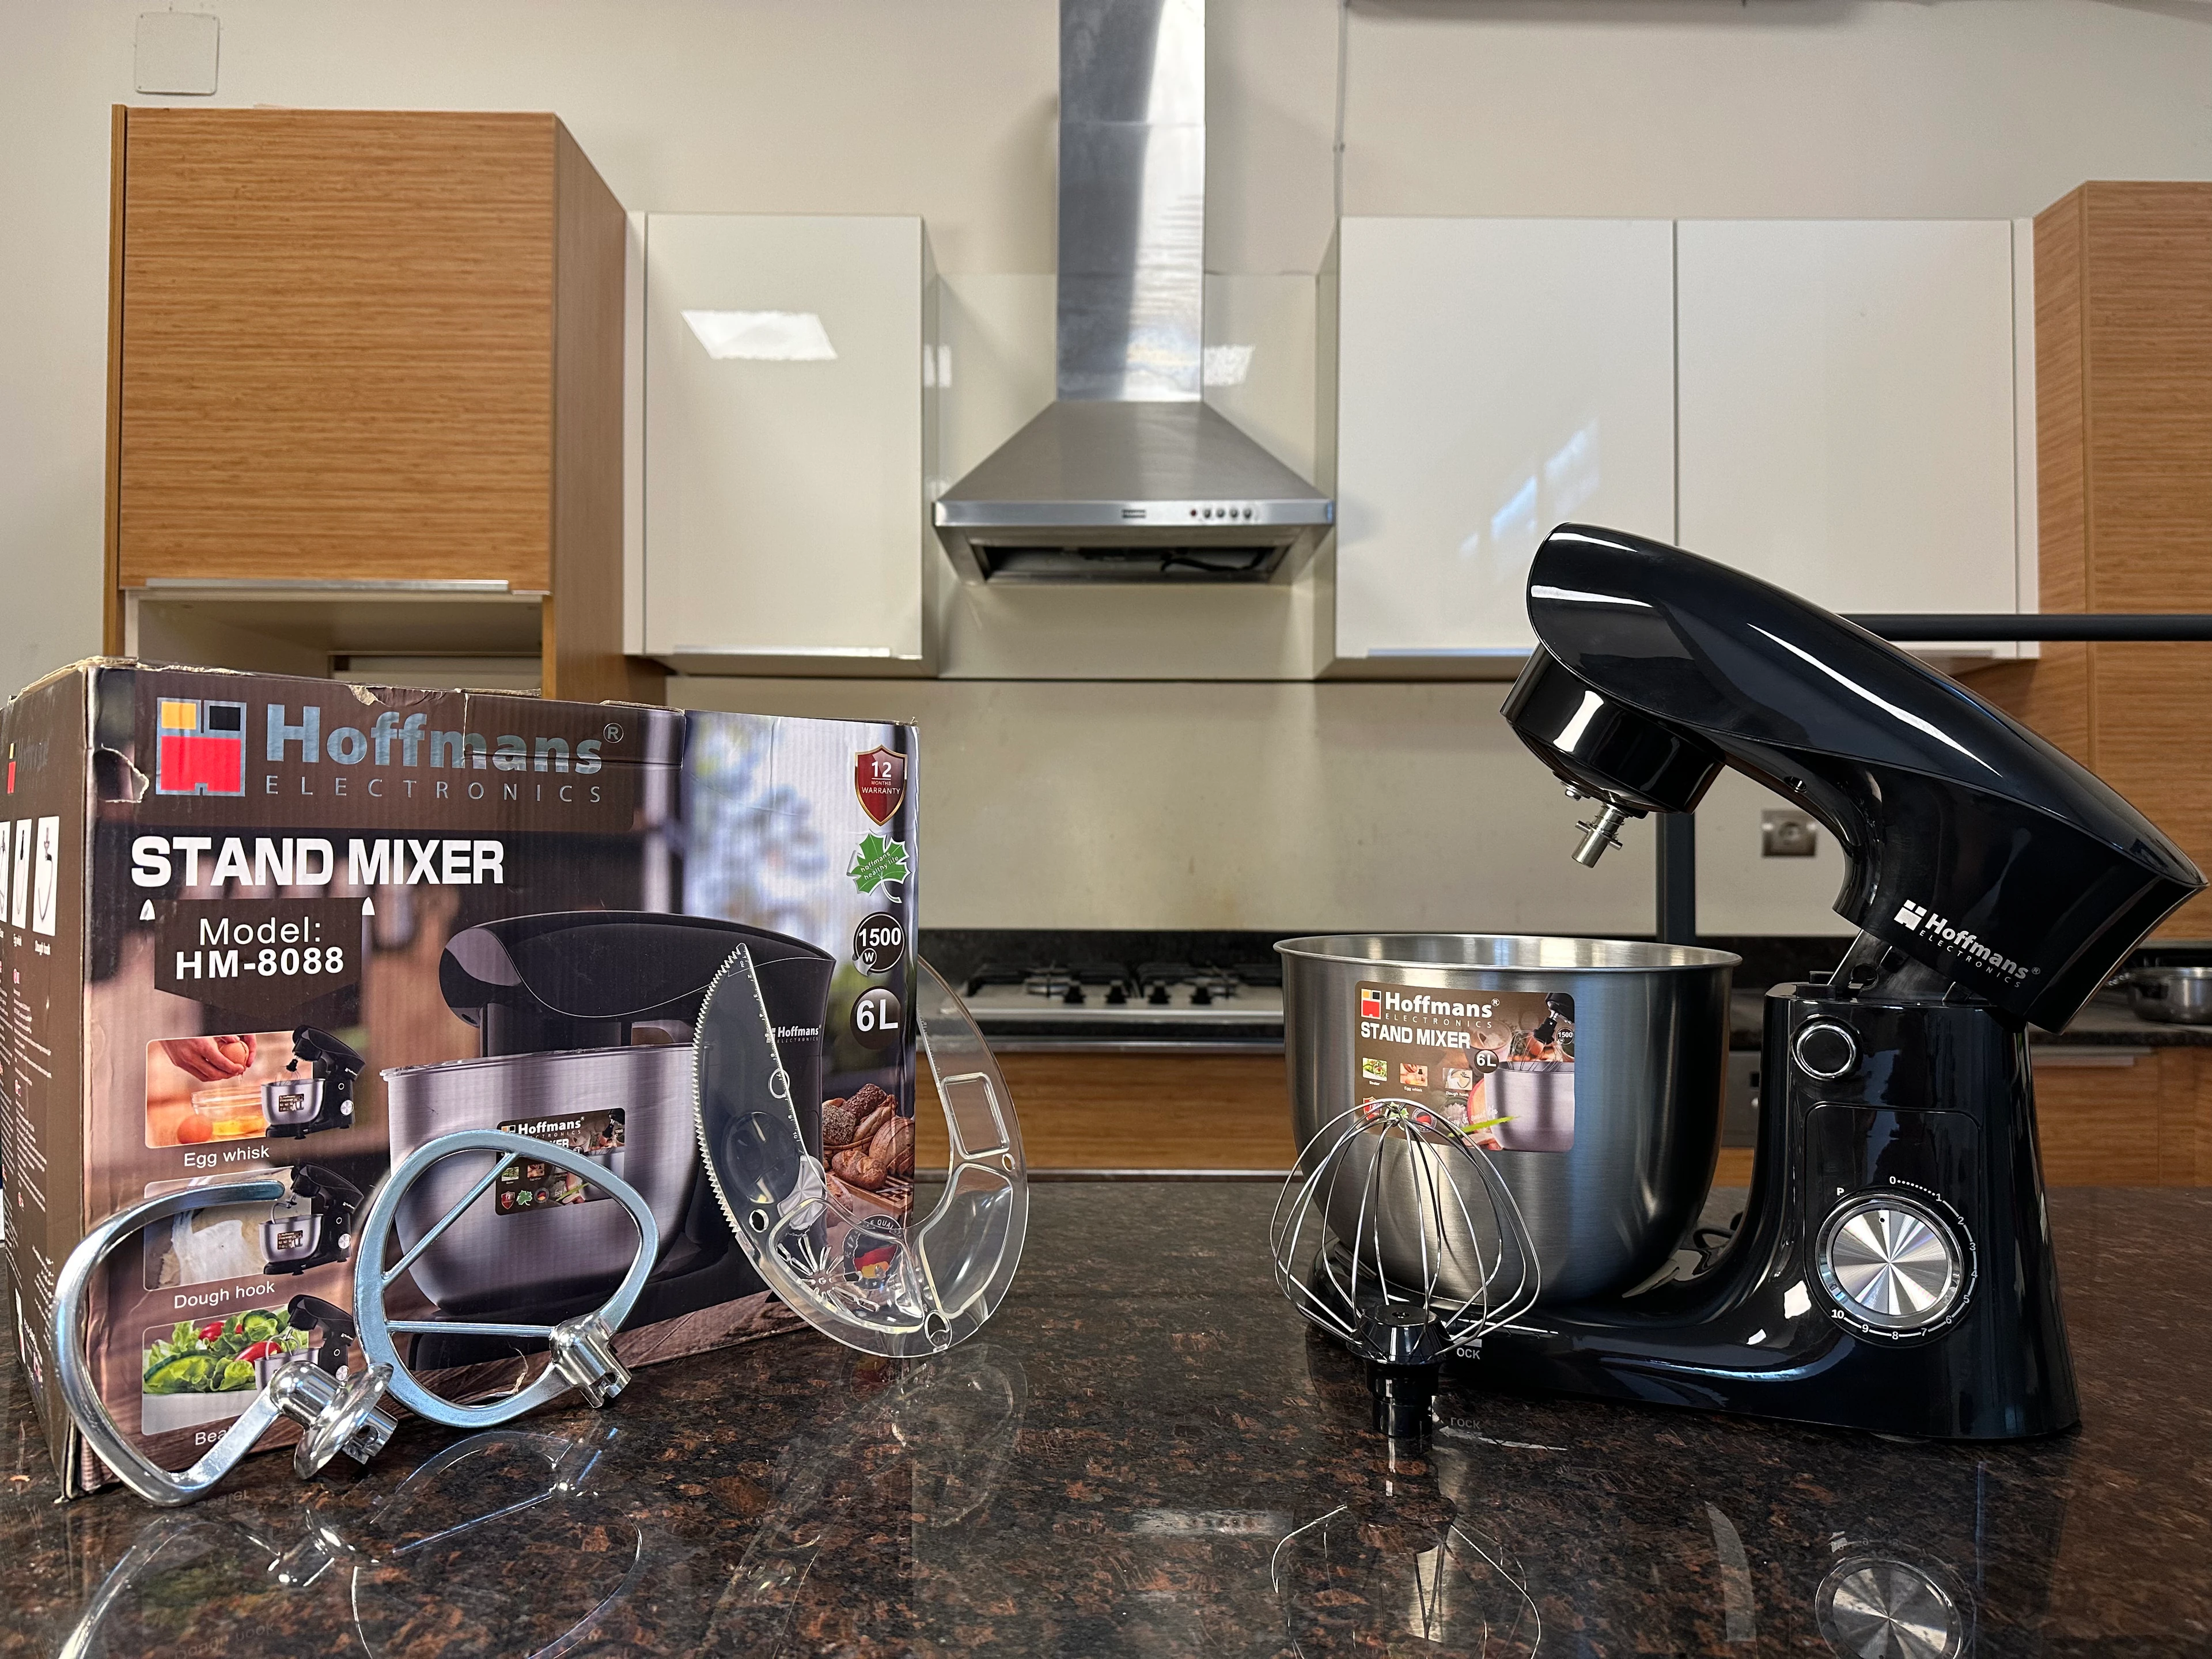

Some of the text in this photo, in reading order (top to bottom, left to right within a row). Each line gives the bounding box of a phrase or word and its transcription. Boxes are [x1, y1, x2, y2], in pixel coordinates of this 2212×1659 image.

[872, 761, 892, 778] 12
[266, 775, 601, 804] ELECTRONICS
[861, 786, 900, 795] WARRANTY
[131, 836, 505, 888] STAND MIXER
[860, 851, 891, 873] hoffmans
[863, 855, 899, 881] healthy life
[199, 916, 321, 946] Model:
[858, 927, 902, 947] 1500
[176, 946, 344, 980] HM-8088
[863, 952, 874, 963] W
[1919, 930, 2021, 988] ELECTRONICS
[856, 998, 899, 1032] 6L
[1385, 1013, 1493, 1029] ELECTRONICS
[1361, 1021, 1471, 1049] STAND MIXER
[1476, 1054, 1497, 1067] 6L
[184, 1145, 270, 1169] Egg whisk
[1837, 1187, 1845, 1196] P
[1936, 1193, 1942, 1202] 1
[1957, 1217, 1964, 1225] 2
[1969, 1243, 1976, 1251] 3
[1971, 1270, 1978, 1278] 4
[174, 1281, 275, 1309] Dough hook
[1963, 1295, 1970, 1304] 5
[1831, 1309, 1845, 1319] 10
[1945, 1315, 1952, 1324] 6
[1862, 1324, 1869, 1332] 9
[1892, 1331, 1899, 1340] 8
[1921, 1328, 1928, 1337] 7
[195, 1426, 232, 1446] Bea
